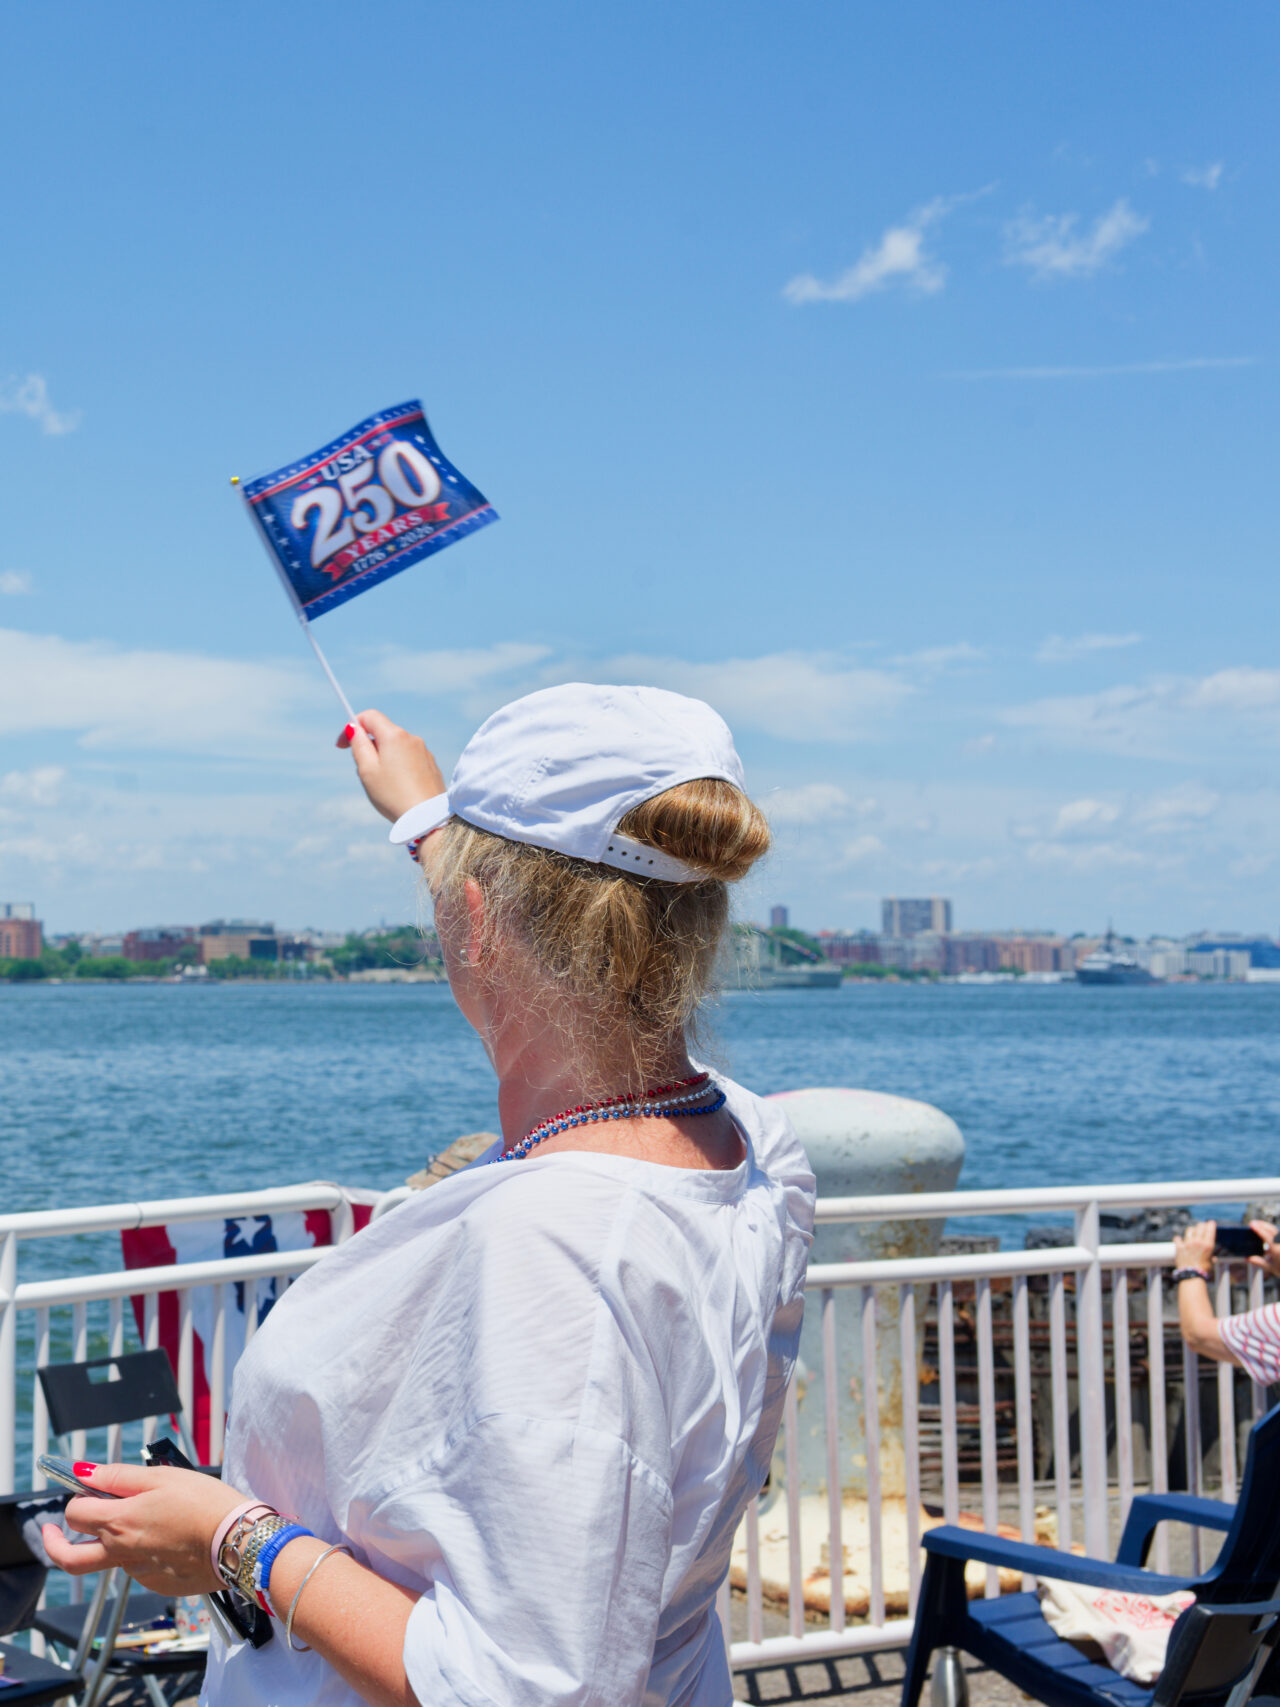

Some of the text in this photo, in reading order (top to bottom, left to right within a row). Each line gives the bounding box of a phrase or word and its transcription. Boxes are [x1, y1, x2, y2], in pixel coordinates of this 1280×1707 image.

[321, 445, 374, 480] USA
[291, 441, 441, 568] 250
[344, 512, 423, 558] YEARS
[352, 523, 434, 573] 1776 2026
